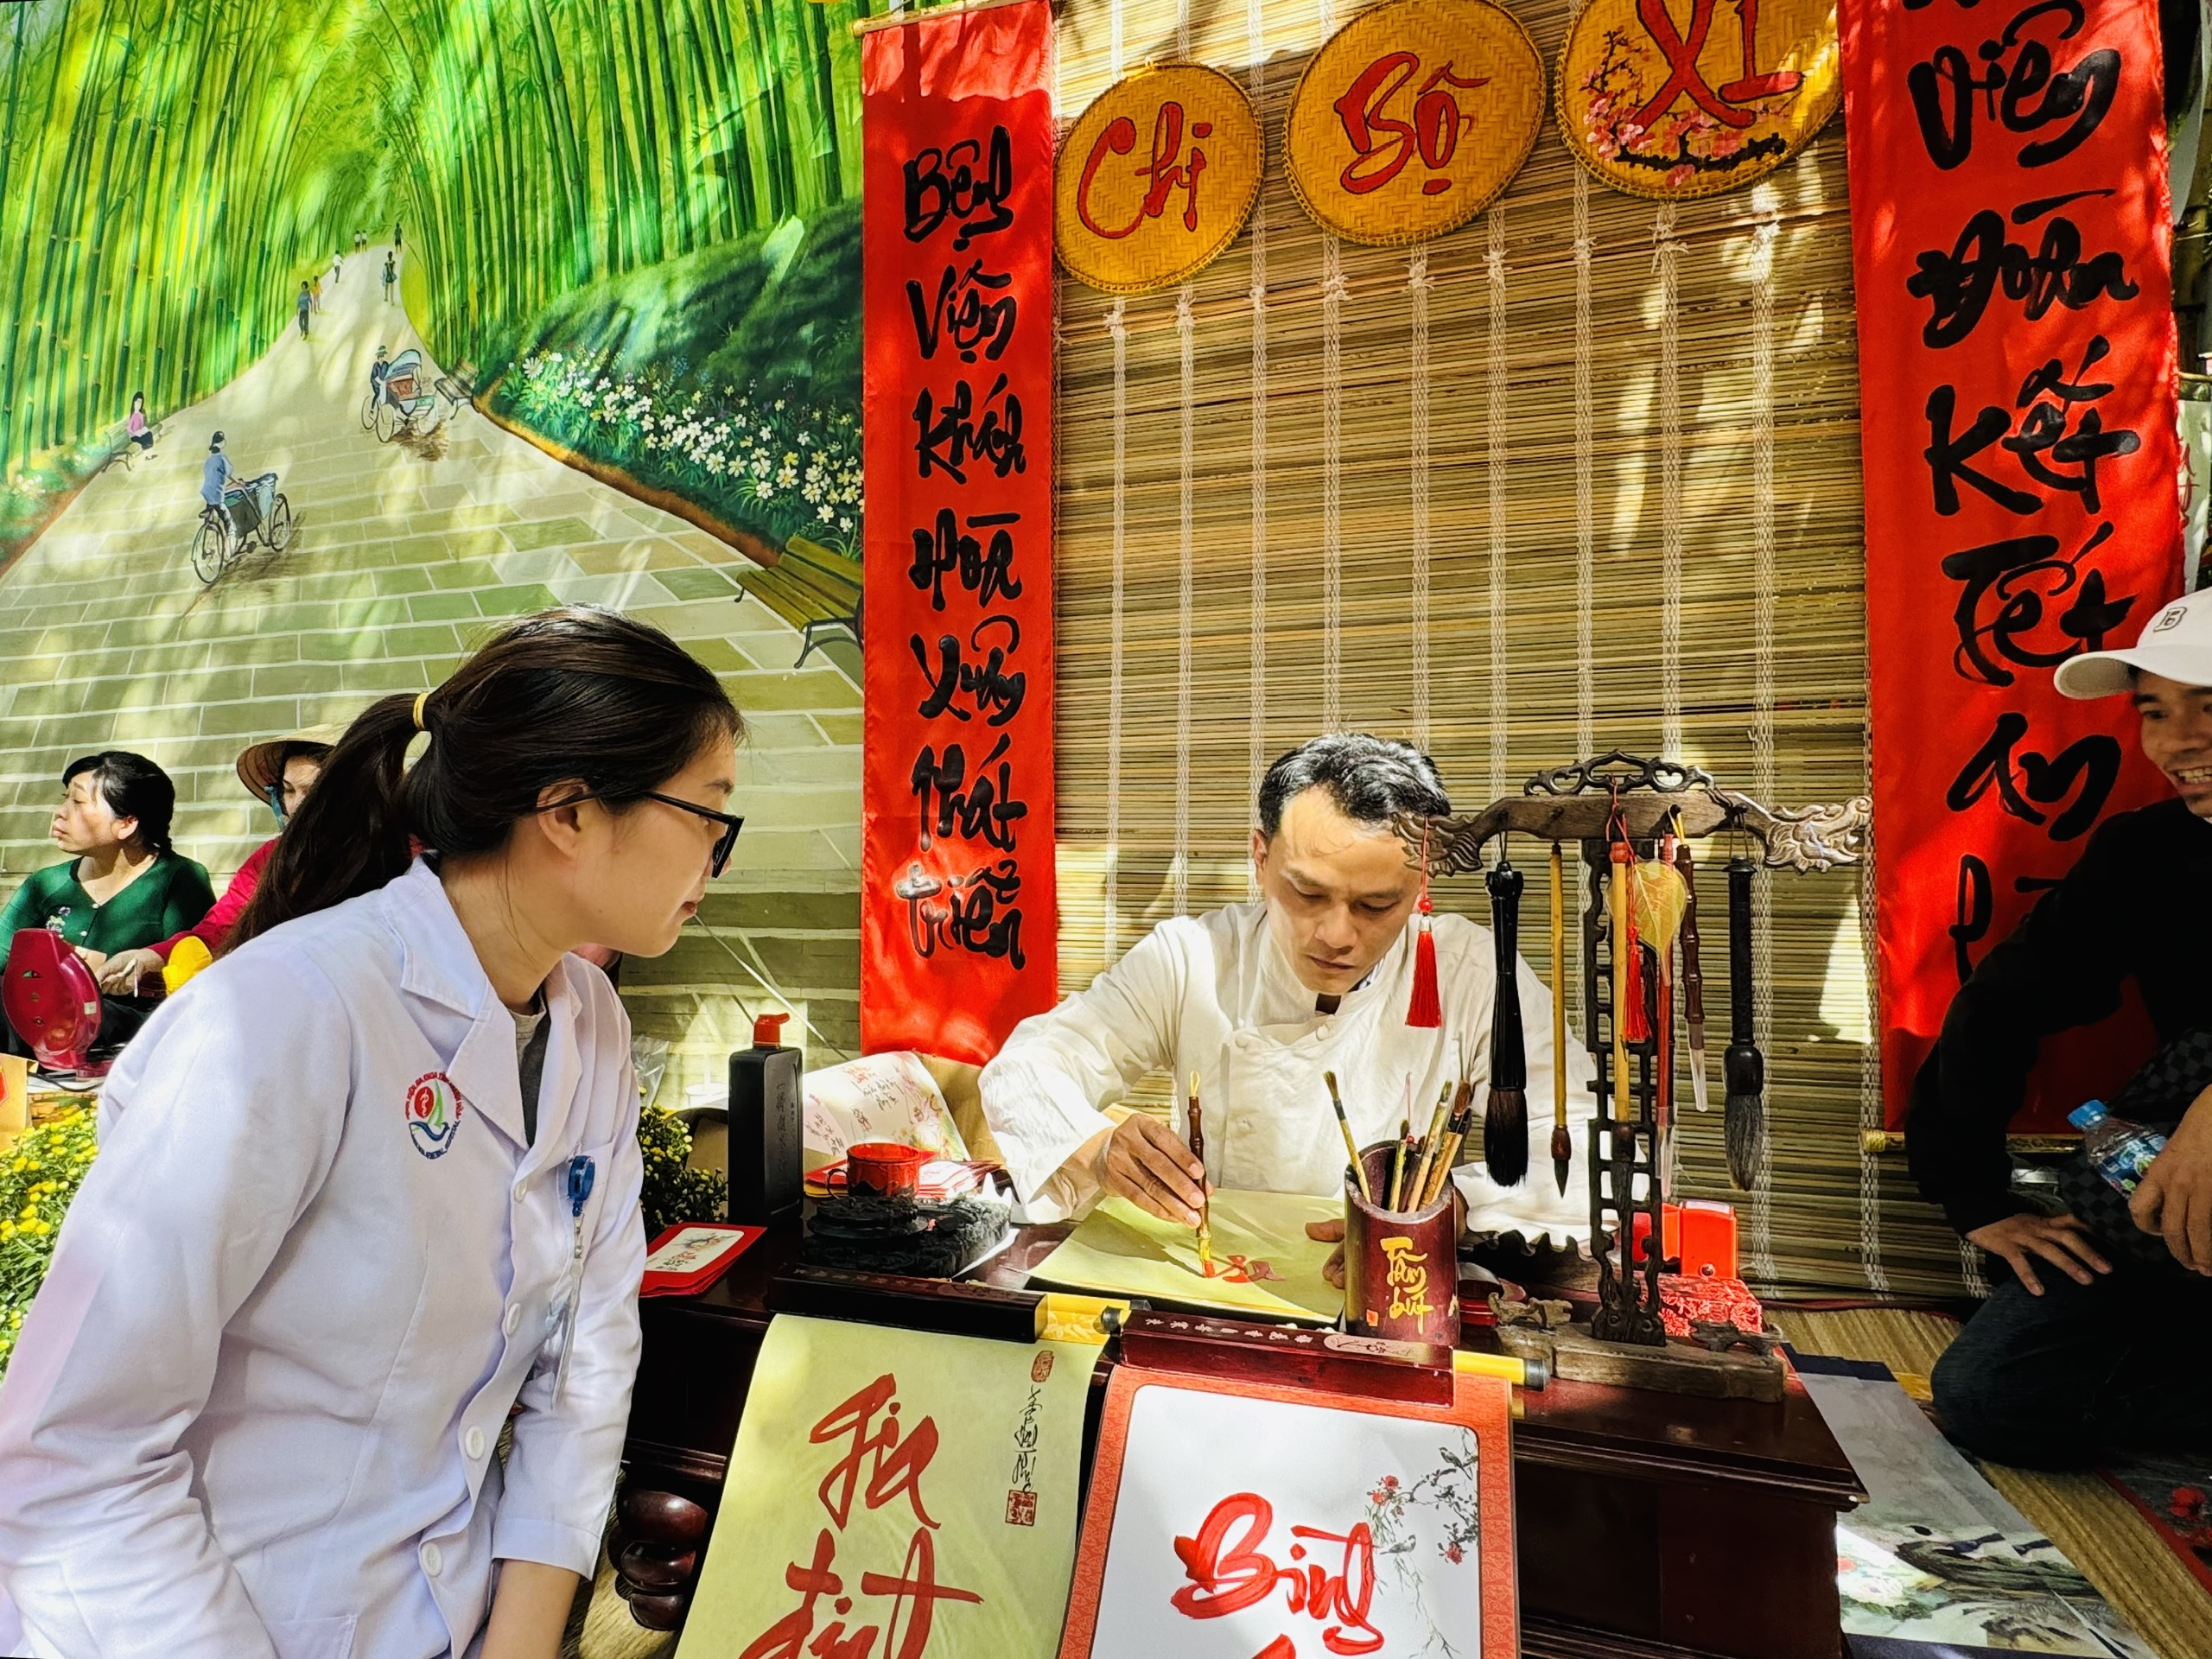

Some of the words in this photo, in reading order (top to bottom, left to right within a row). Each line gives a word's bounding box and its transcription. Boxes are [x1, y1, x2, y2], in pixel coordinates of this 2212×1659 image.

[902, 125, 1014, 252] Bệnh
[1077, 102, 1213, 239] Chi
[1333, 51, 1492, 195] Bộ
[906, 259, 1017, 363] Viện
[1906, 188, 2139, 349] Đoàn
[1923, 334, 2140, 517] Kết
[1941, 521, 2139, 687] Tết
[1380, 1236, 1428, 1294] Tâm
